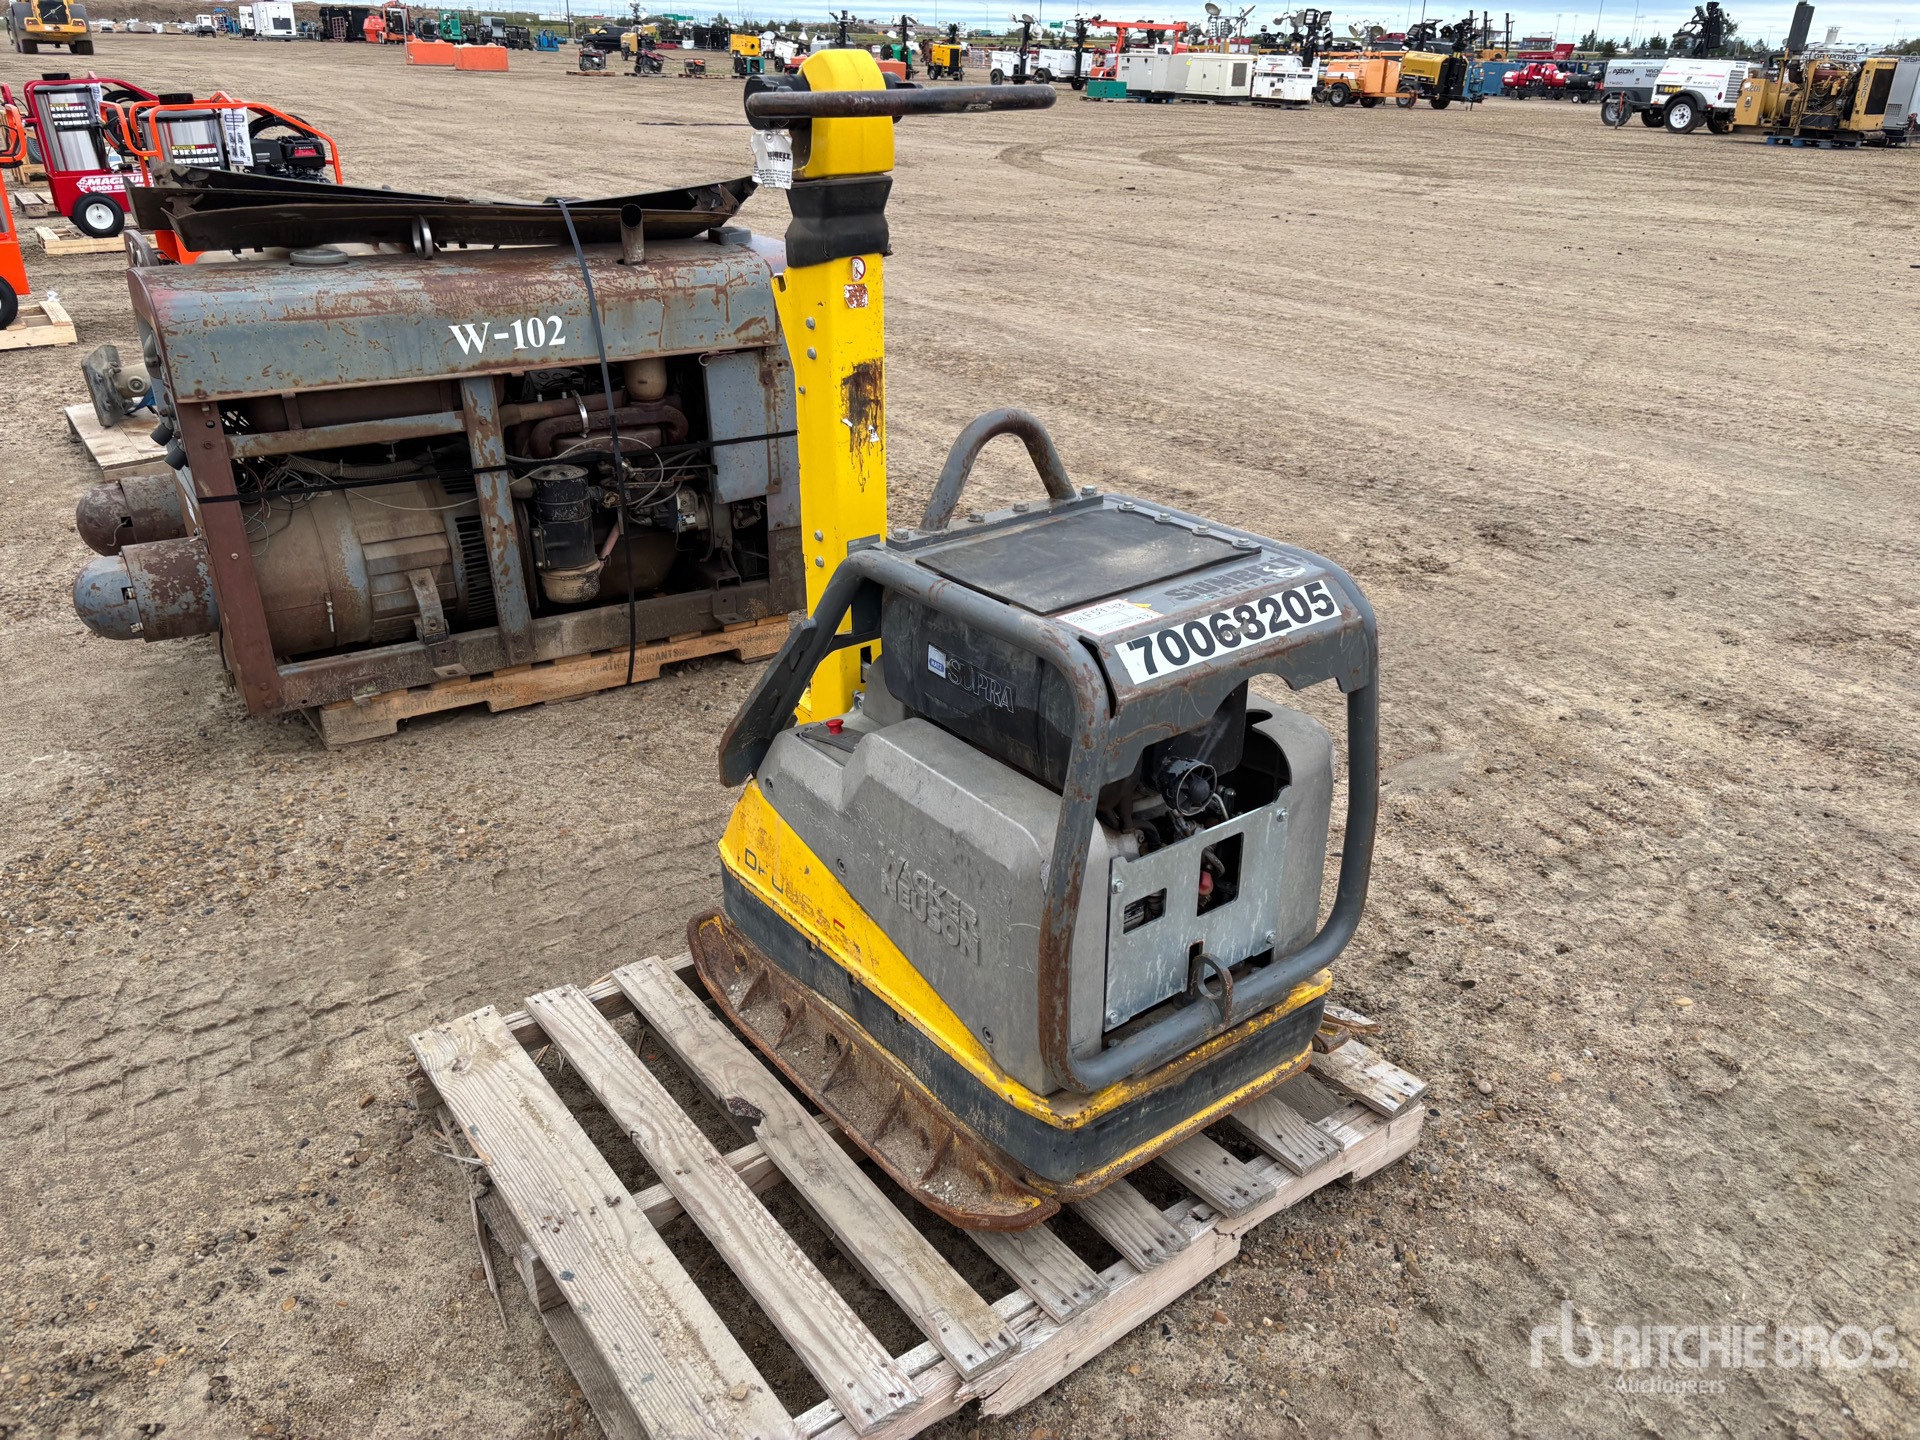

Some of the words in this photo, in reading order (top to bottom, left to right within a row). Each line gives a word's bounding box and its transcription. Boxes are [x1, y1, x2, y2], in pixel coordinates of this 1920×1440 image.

[448, 315, 566, 356] W-102
[1127, 581, 1336, 676] 70068205
[947, 658, 1015, 714] SUPRA
